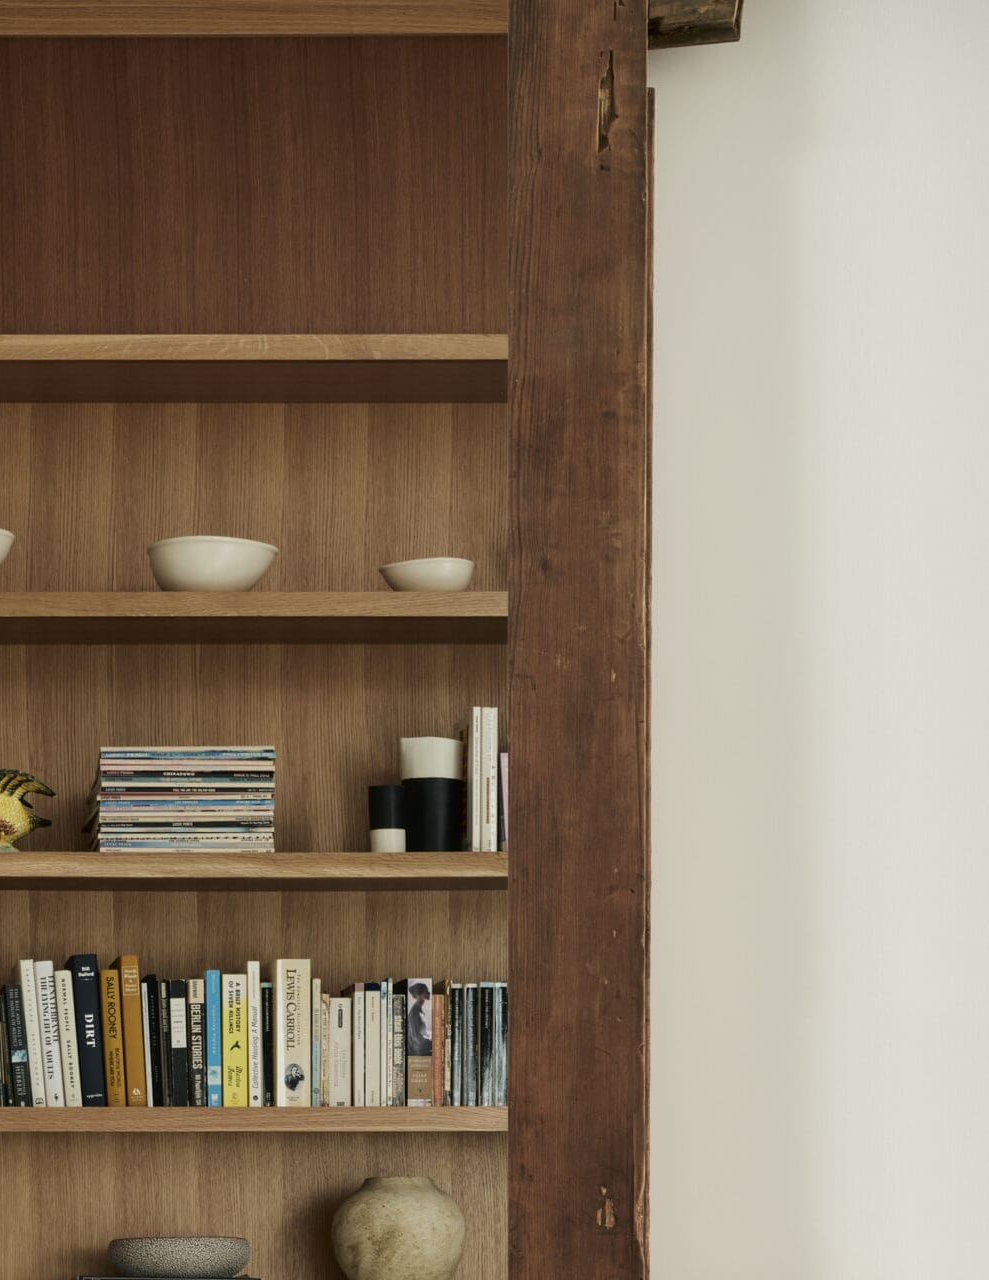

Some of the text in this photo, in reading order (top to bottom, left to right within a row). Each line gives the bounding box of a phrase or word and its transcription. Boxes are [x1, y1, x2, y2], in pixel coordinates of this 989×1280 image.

[40, 976, 48, 991] THE
[228, 980, 234, 989] OF
[42, 993, 50, 1018] LYING
[47, 975, 59, 1043] ELENA FERRANTE
[106, 976, 117, 1040] SALLY ROONEY
[286, 969, 297, 1051] LEWIS CARROLL
[45, 1036, 52, 1046] OF
[84, 1014, 96, 1048] DIRT
[191, 1004, 203, 1070] BERLIN STORIES
[46, 1049, 55, 1080] ADULTS
[251, 1060, 259, 1089] Collective
